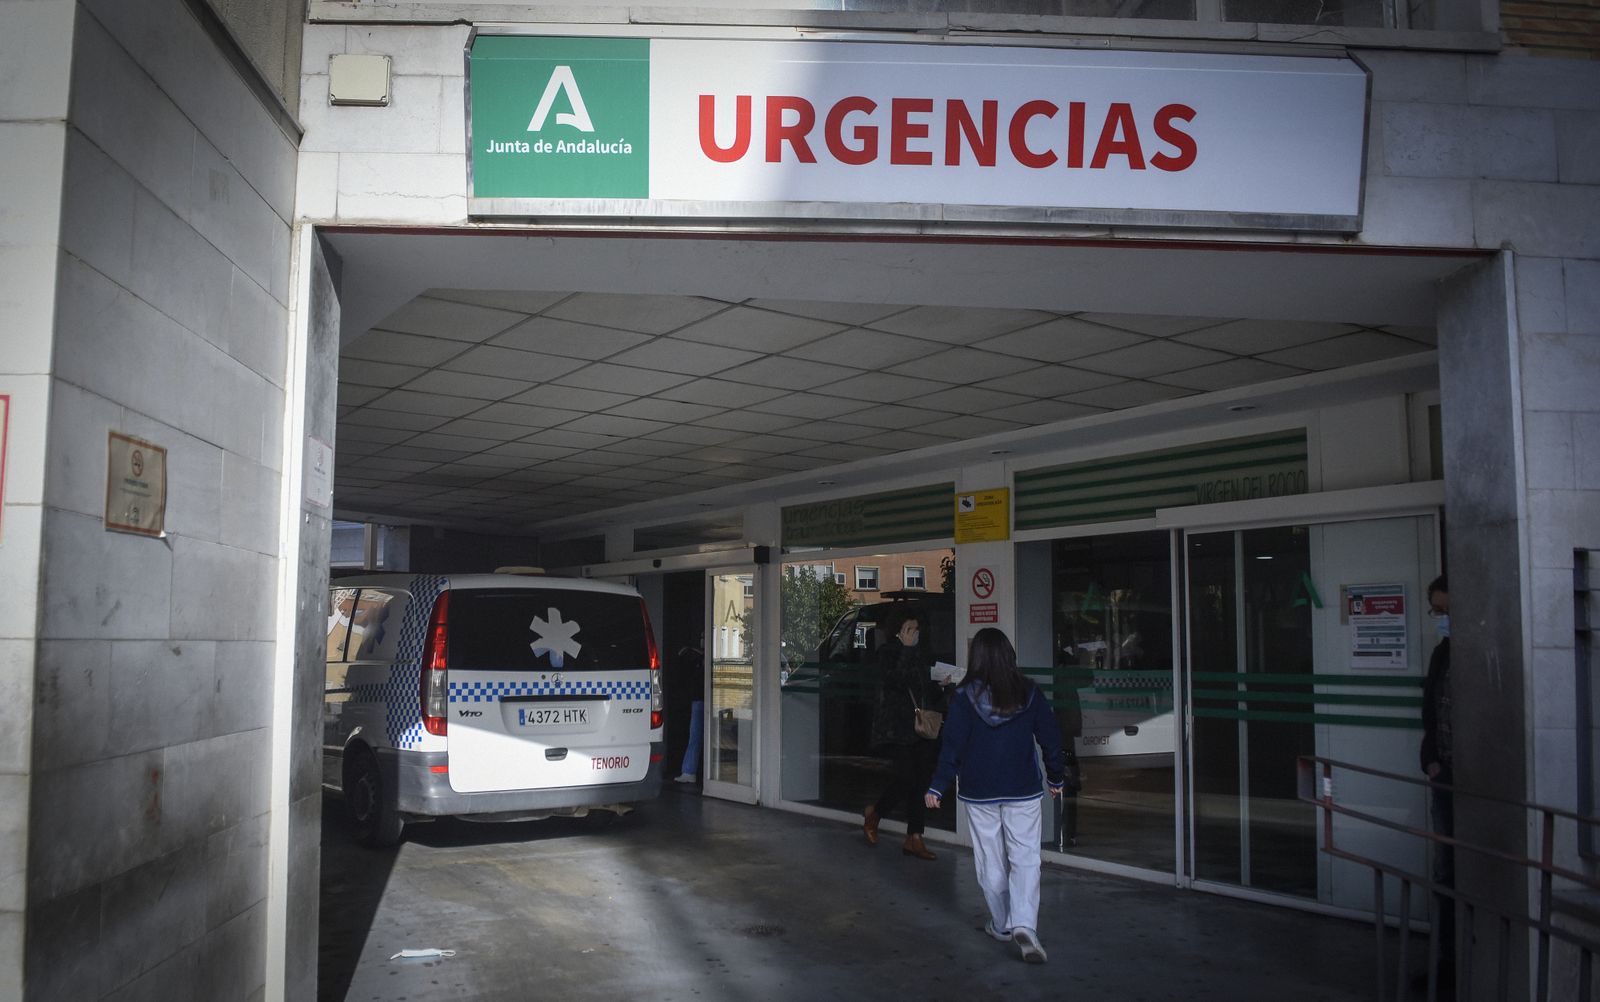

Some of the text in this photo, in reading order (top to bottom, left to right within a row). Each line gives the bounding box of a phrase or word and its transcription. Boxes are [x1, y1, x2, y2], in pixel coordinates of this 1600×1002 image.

[698, 94, 1197, 172] URGENCIAS
[486, 138, 632, 154] Junta de Andalucía
[528, 709, 586, 724] 4372 HTK
[591, 756, 630, 769] TENORIO
